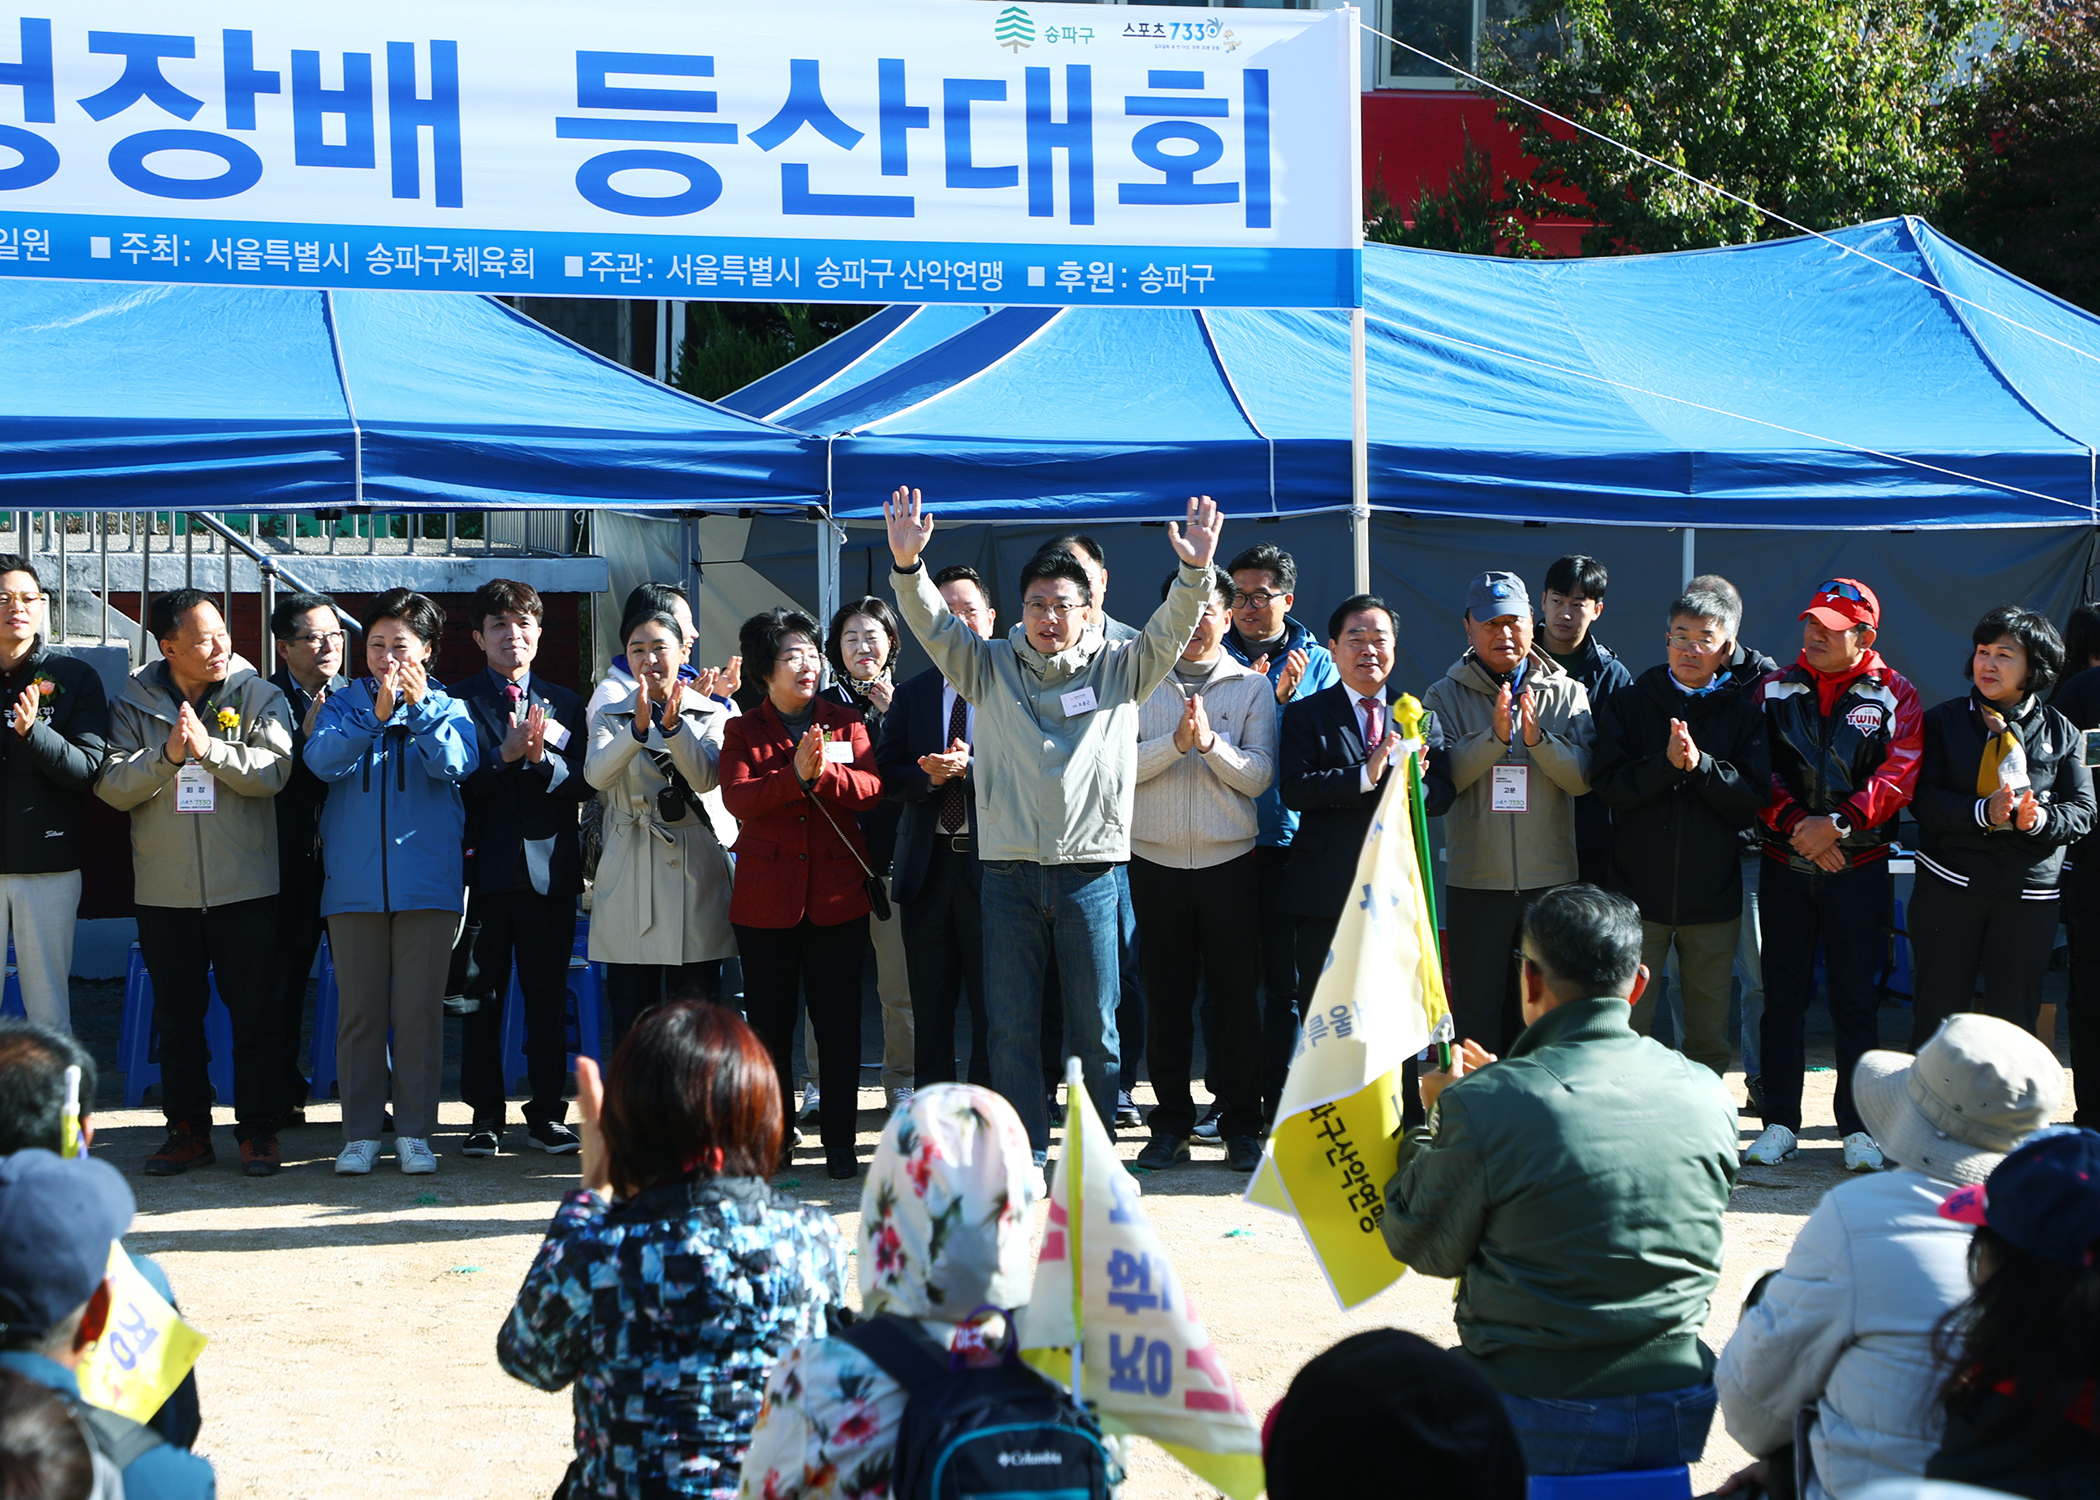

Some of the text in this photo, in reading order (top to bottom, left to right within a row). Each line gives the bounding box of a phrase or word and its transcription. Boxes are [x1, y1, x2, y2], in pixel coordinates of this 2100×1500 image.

[1043, 25, 1096, 45] 송파구
[1122, 22, 1167, 38] 스포츠
[555, 50, 1271, 229] 등산대회
[120, 233, 191, 267] 주최:
[205, 238, 349, 274] 서울특별시
[365, 243, 534, 280] 송파구체육회
[588, 252, 653, 284] 주관:
[666, 254, 799, 288] 서울특별시
[1138, 263, 1216, 294] 송파구
[1010, 1448, 1063, 1467] Columbia
